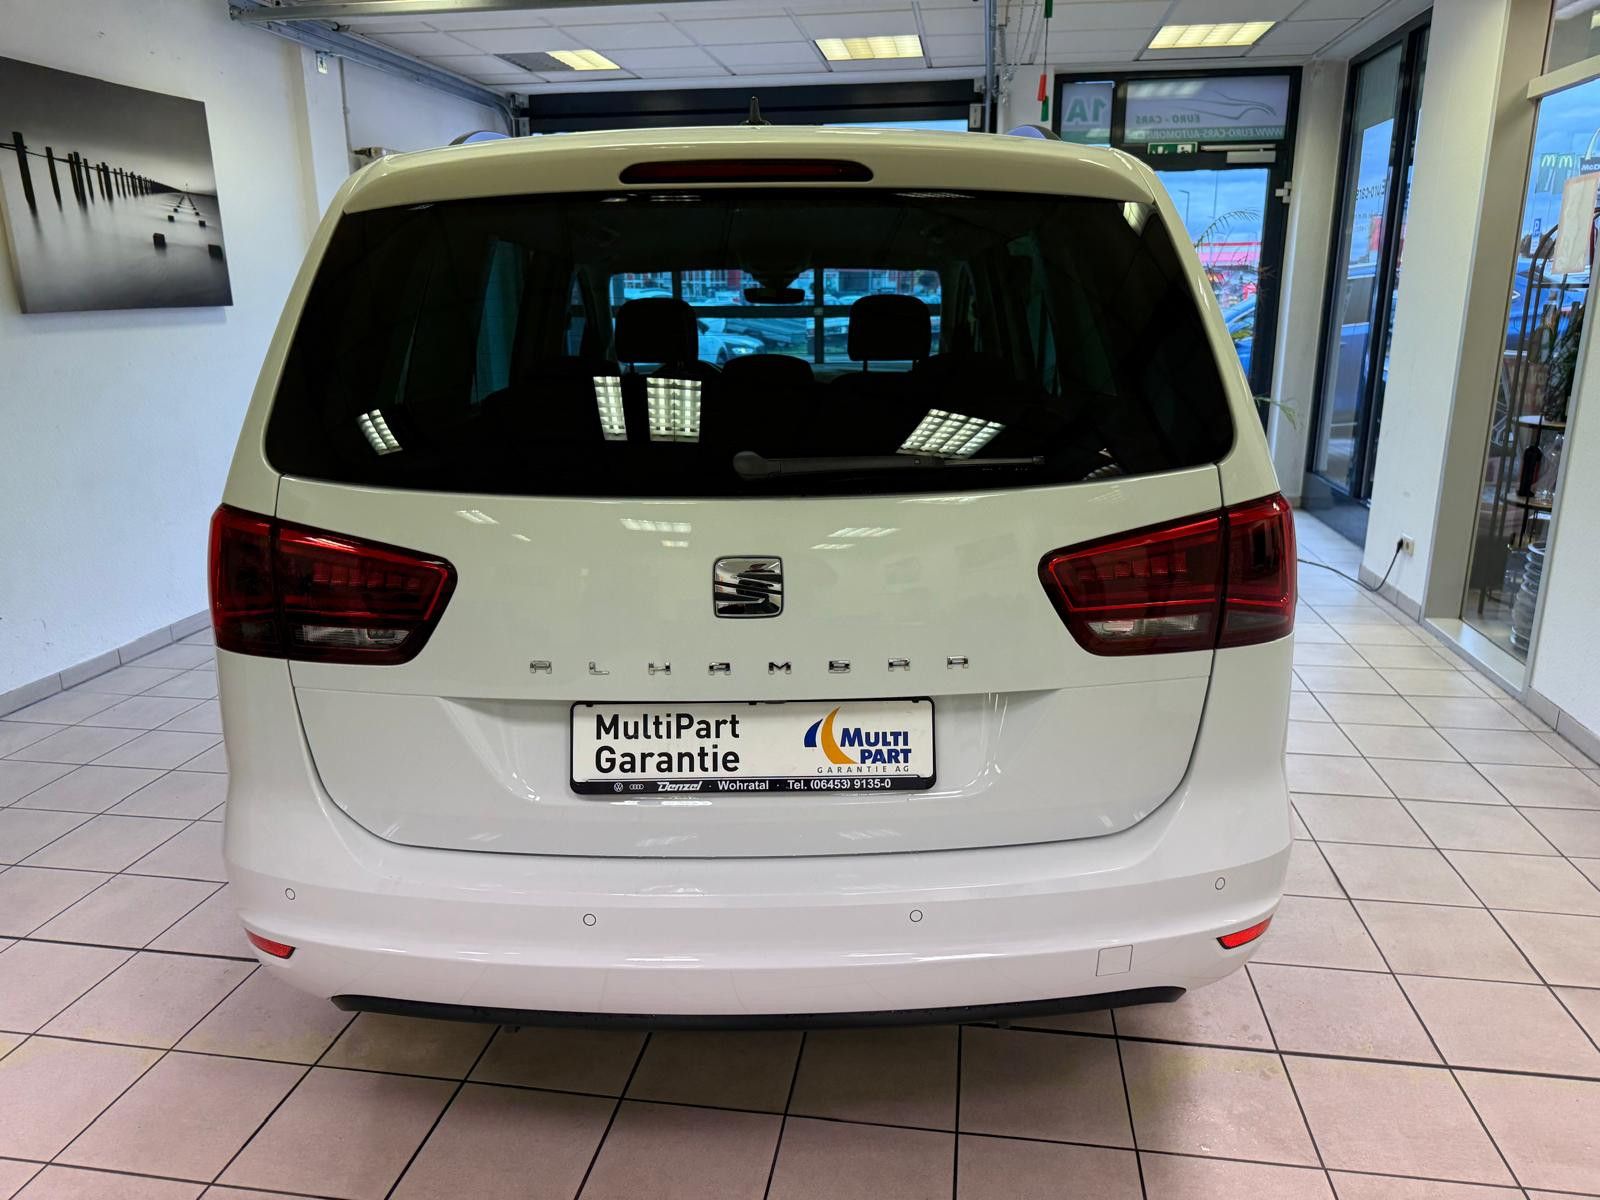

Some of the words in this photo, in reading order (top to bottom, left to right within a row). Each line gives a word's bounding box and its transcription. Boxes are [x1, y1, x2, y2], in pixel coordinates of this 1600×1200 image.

[529, 655, 969, 676] ALHAMBRA
[595, 713, 740, 740] MultiPart
[840, 727, 909, 747] MULTI
[595, 744, 740, 774] Garantie
[860, 748, 912, 764] PART
[817, 765, 887, 774] GARANTIE
[895, 765, 909, 773] AG
[656, 781, 703, 792] Denzel
[717, 780, 769, 791] Wohratal
[787, 779, 807, 790] Tel.
[810, 778, 851, 790] (06453)
[853, 778, 892, 789] 9135-0
